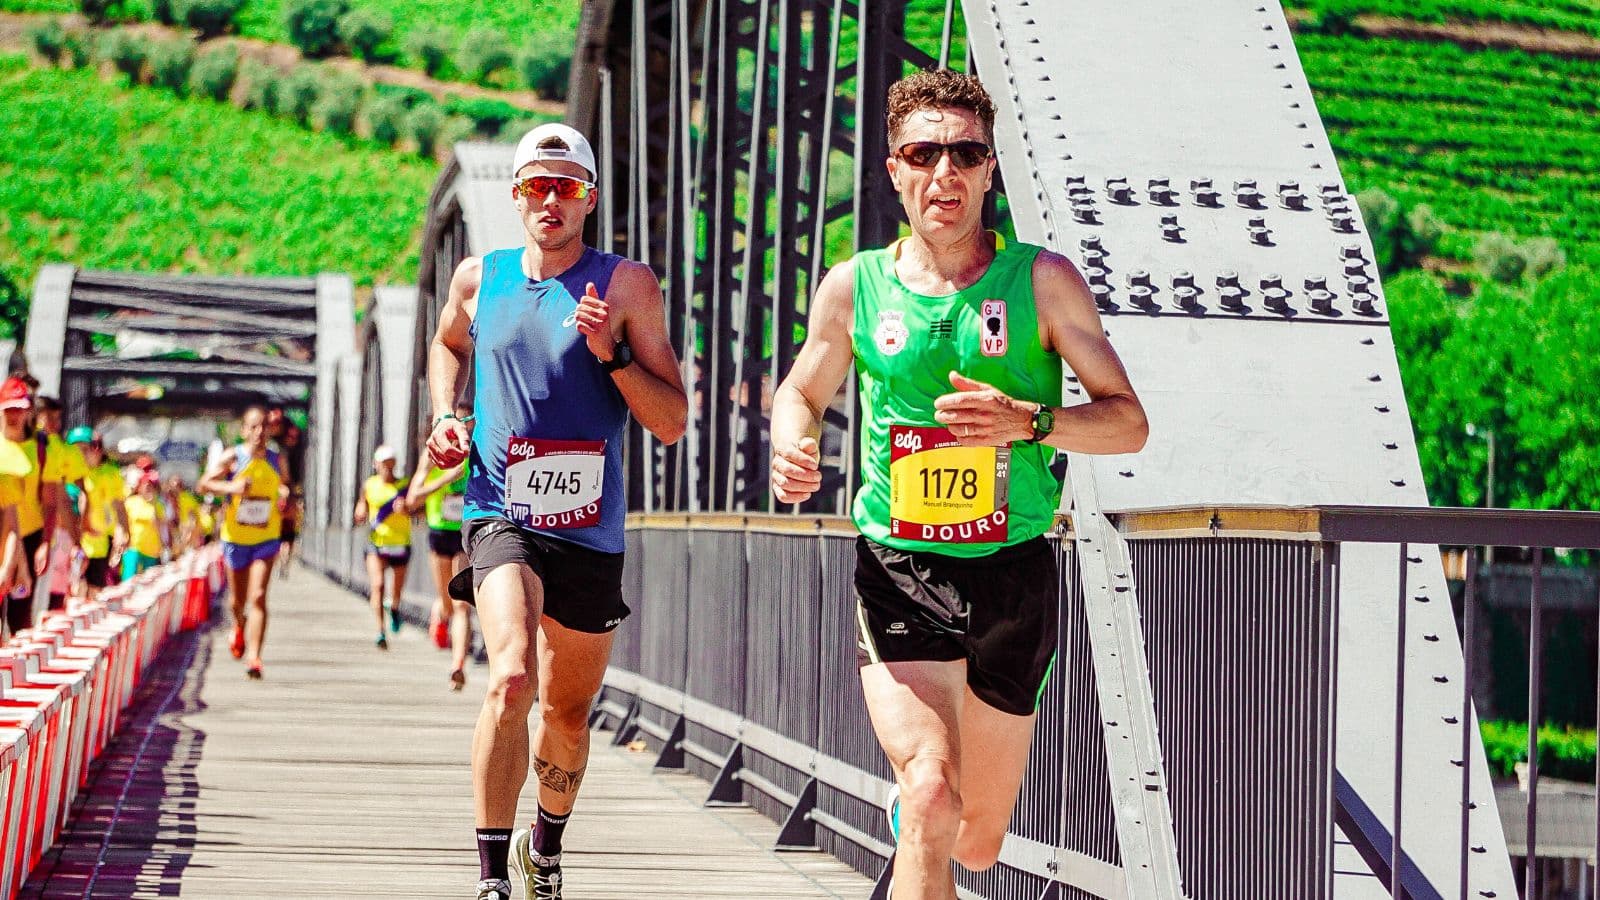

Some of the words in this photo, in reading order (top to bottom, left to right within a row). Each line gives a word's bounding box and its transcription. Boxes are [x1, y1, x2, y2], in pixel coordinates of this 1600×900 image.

[985, 304, 992, 315] G
[996, 304, 1002, 315] J
[985, 339, 992, 351] V
[996, 339, 1003, 351] P
[510, 441, 535, 459] edp
[894, 430, 922, 454] edp
[527, 470, 581, 495] 4745
[919, 467, 978, 500] 1178
[512, 504, 530, 521] VIP
[532, 502, 598, 527] DOURO
[922, 510, 1006, 540] DOURO
